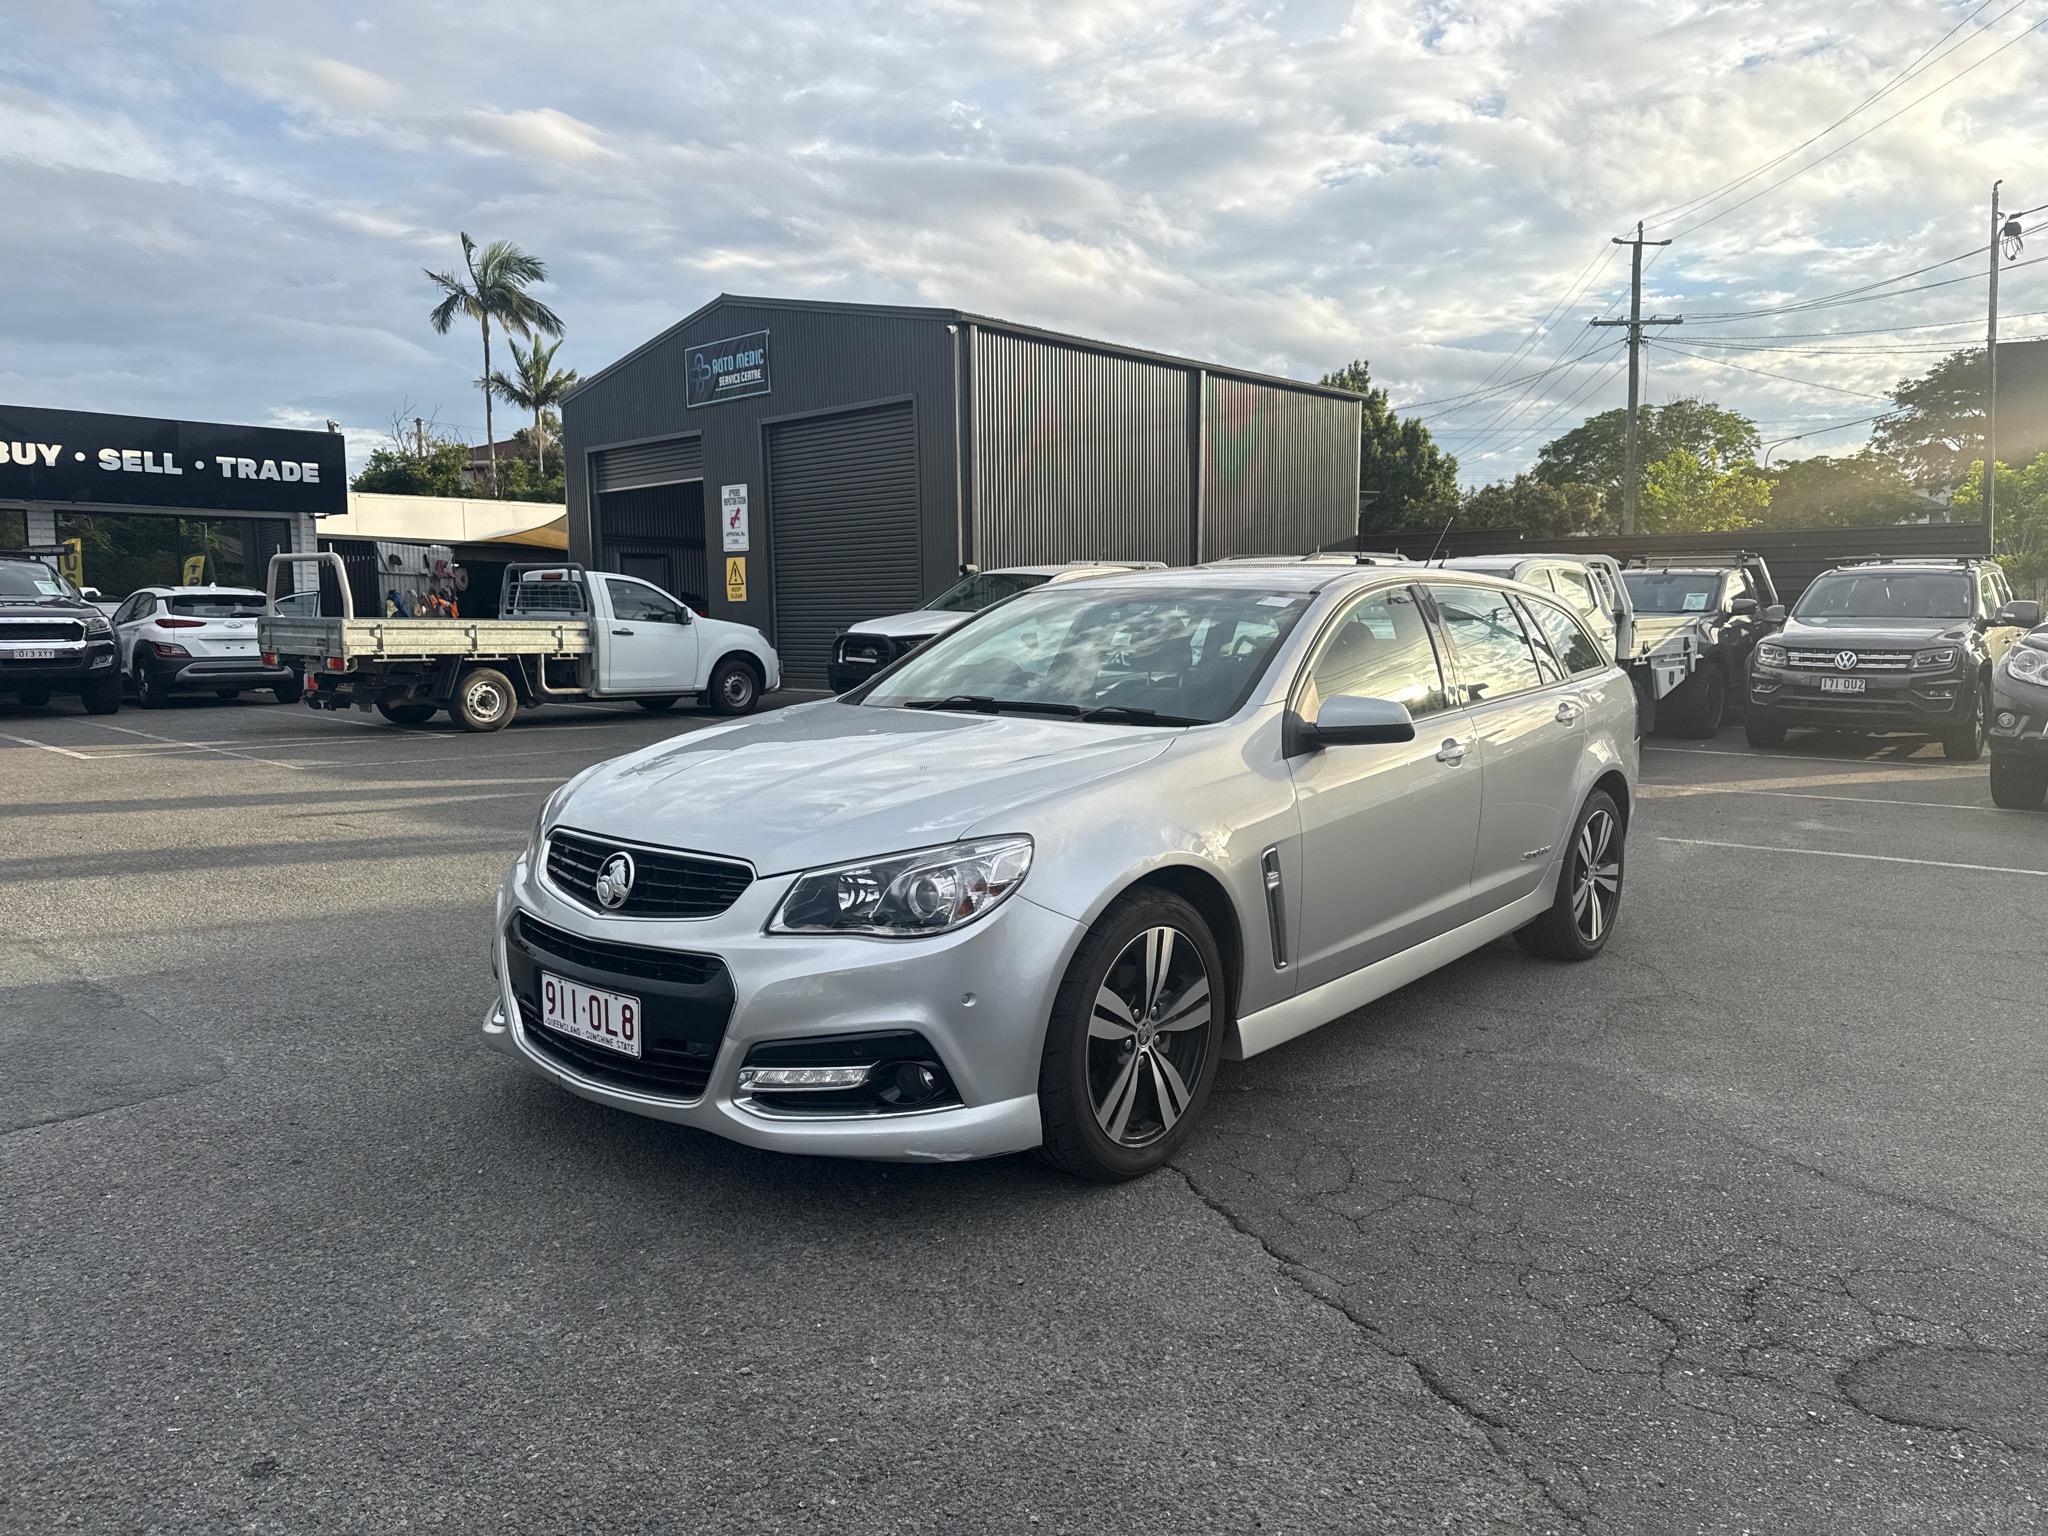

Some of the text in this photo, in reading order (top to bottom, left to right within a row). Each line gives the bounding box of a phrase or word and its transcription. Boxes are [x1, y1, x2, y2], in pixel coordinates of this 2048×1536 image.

[712, 349, 764, 374] AUTO MEDIC
[719, 368, 762, 387] SERVICE CENTRE
[98, 448, 183, 475] SELL
[215, 456, 320, 484] TRADE
[546, 1017, 634, 1054] QUEENSLAND SUNSHINE STATE
